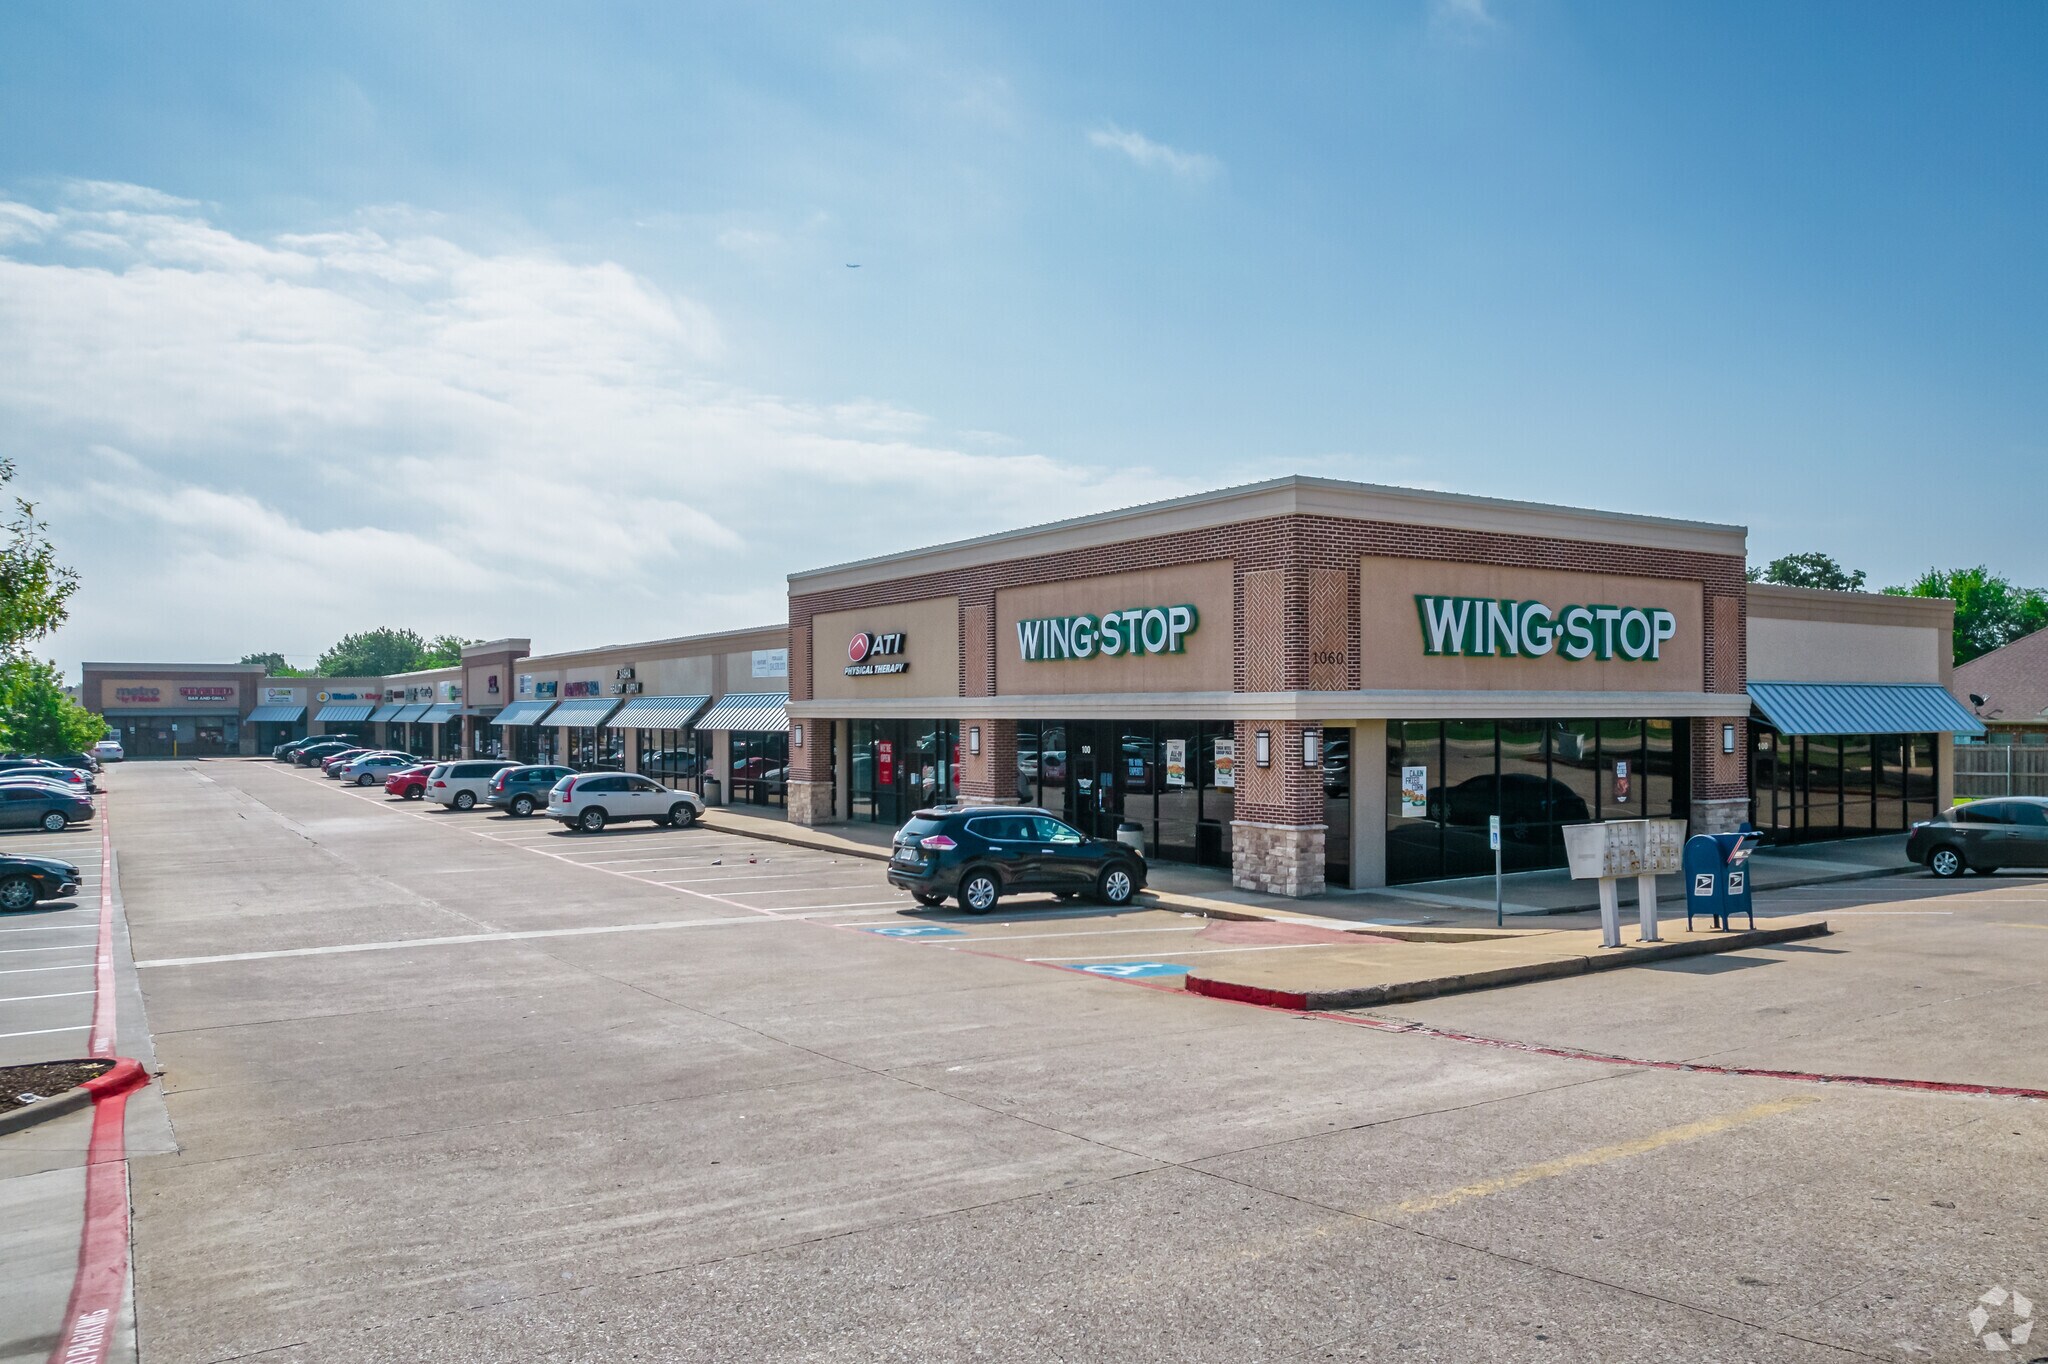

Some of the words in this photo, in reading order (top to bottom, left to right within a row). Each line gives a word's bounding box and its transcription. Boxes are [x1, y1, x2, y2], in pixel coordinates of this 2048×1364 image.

[870, 633, 902, 656] ATI
[1313, 651, 1344, 664] 1060
[844, 665, 874, 675] PHYSICAL
[874, 663, 905, 674] THERAPY
[1081, 745, 1091, 754] 100
[880, 754, 891, 763] OPEN
[66, 1308, 109, 1358] PARKING
